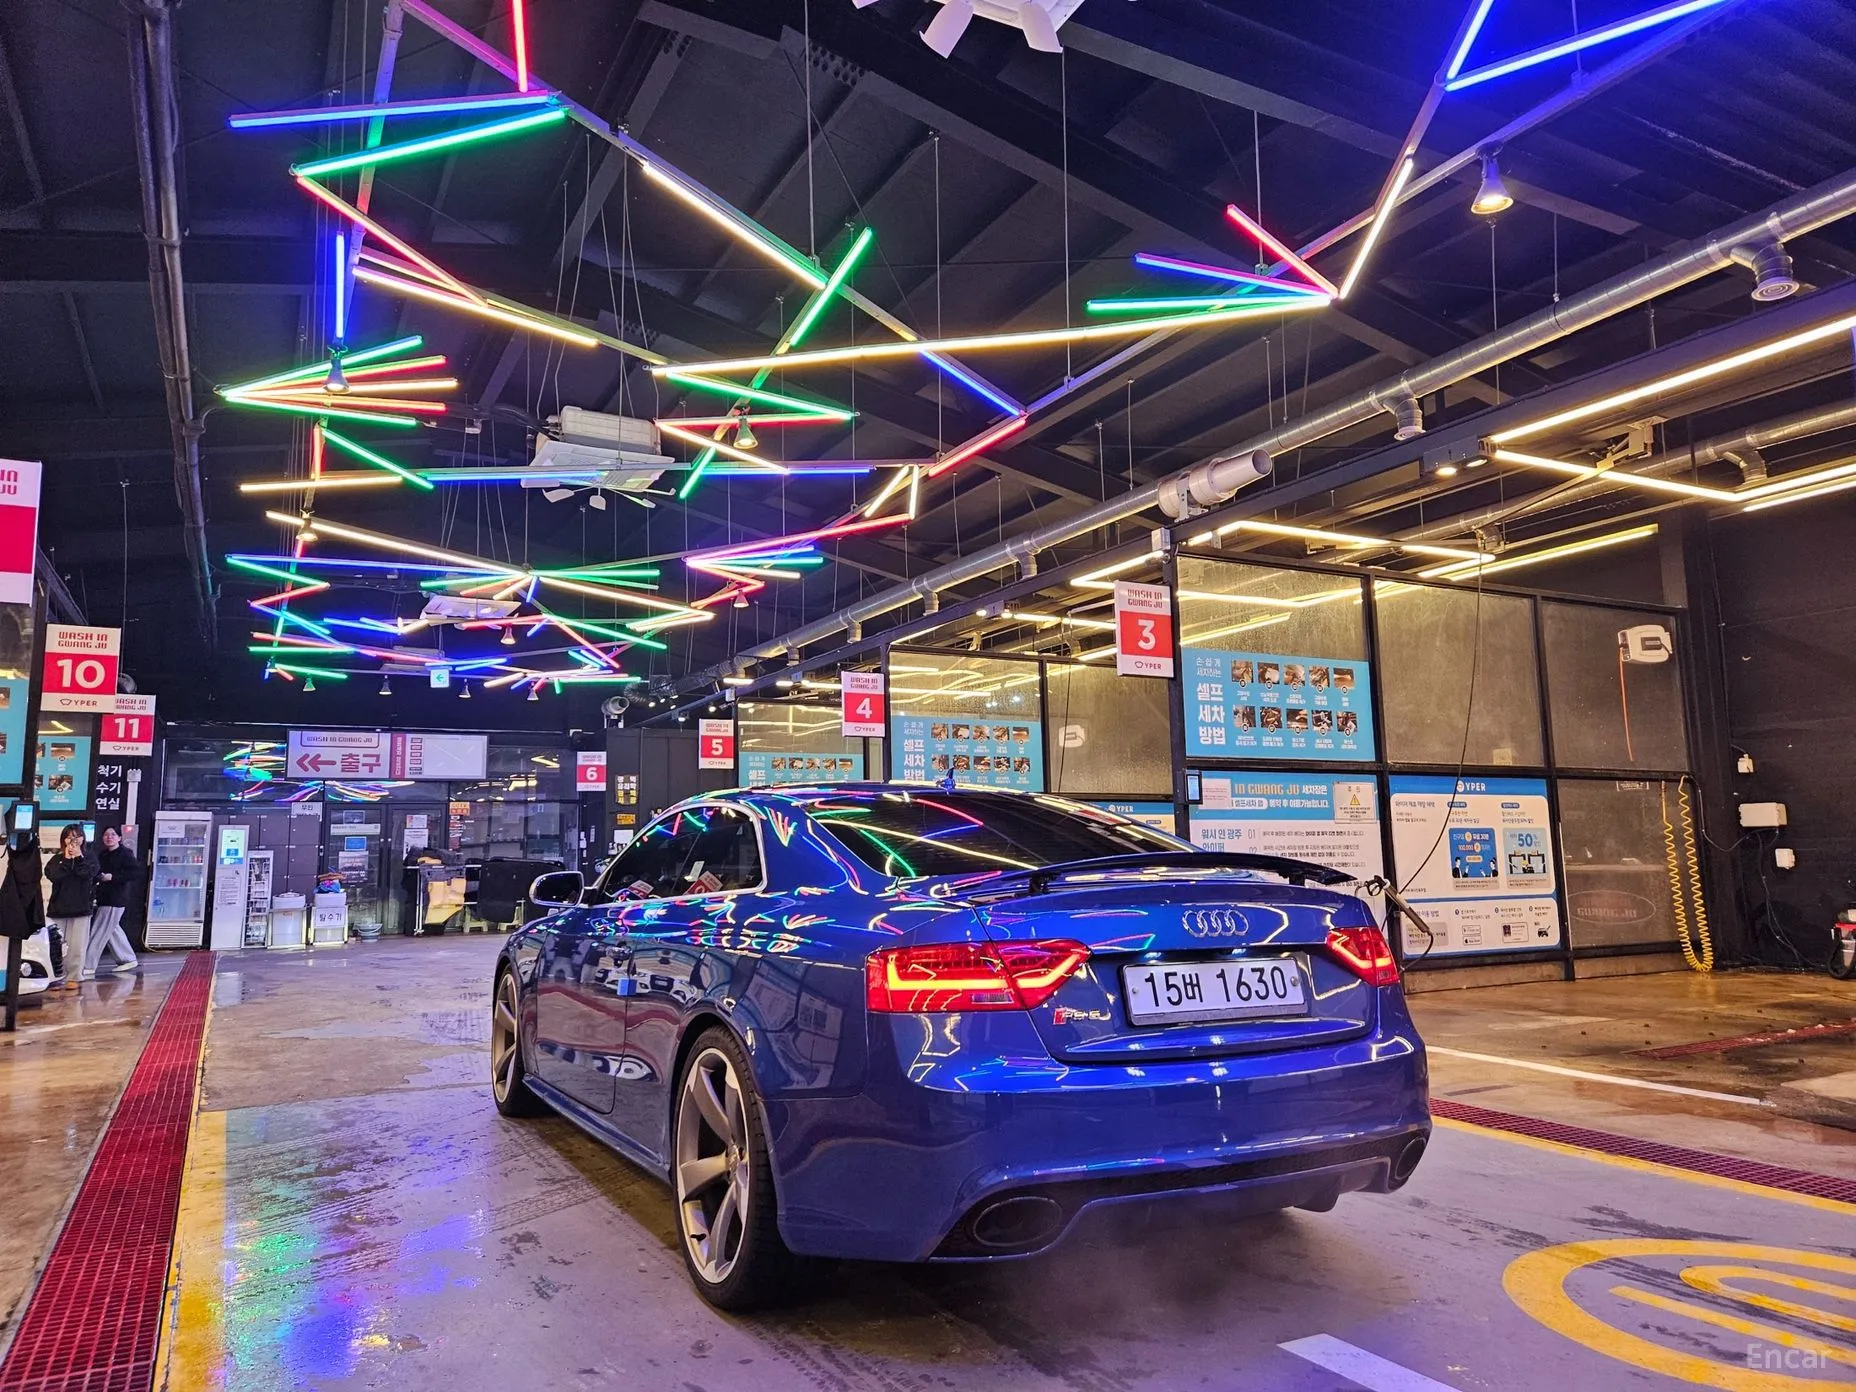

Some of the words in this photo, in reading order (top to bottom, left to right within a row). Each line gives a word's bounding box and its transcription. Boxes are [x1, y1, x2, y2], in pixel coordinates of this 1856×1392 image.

[1128, 588, 1152, 599] WASH
[1127, 598, 1152, 607] GWANG
[58, 631, 94, 641] WASH
[96, 633, 108, 642] IN
[1137, 618, 1156, 651] 3
[58, 640, 92, 649] GWANG
[94, 642, 107, 650] JU
[57, 659, 105, 688] 10
[1197, 682, 1224, 702] 셀프
[856, 697, 873, 719] 4
[1199, 704, 1225, 723] 세차
[115, 718, 139, 739] 11
[1200, 726, 1226, 746] 방법
[711, 738, 724, 756] 5
[903, 739, 925, 752] 셀프
[340, 753, 381, 773] 출구
[904, 754, 925, 767] 세차
[97, 764, 122, 777] 척기
[585, 766, 598, 781] 6
[95, 781, 121, 795] 수기
[1248, 783, 1284, 795] GWANG
[1286, 784, 1300, 796] JU
[1465, 782, 1486, 791] YPER
[95, 797, 121, 811] 연실
[1116, 805, 1134, 813] YPER
[1218, 829, 1226, 840] 인
[1227, 829, 1242, 840] 광주
[1247, 829, 1256, 840] 01
[1518, 833, 1533, 847] 50
[1145, 971, 1203, 1007] 15버
[1215, 965, 1288, 1002] 1630
